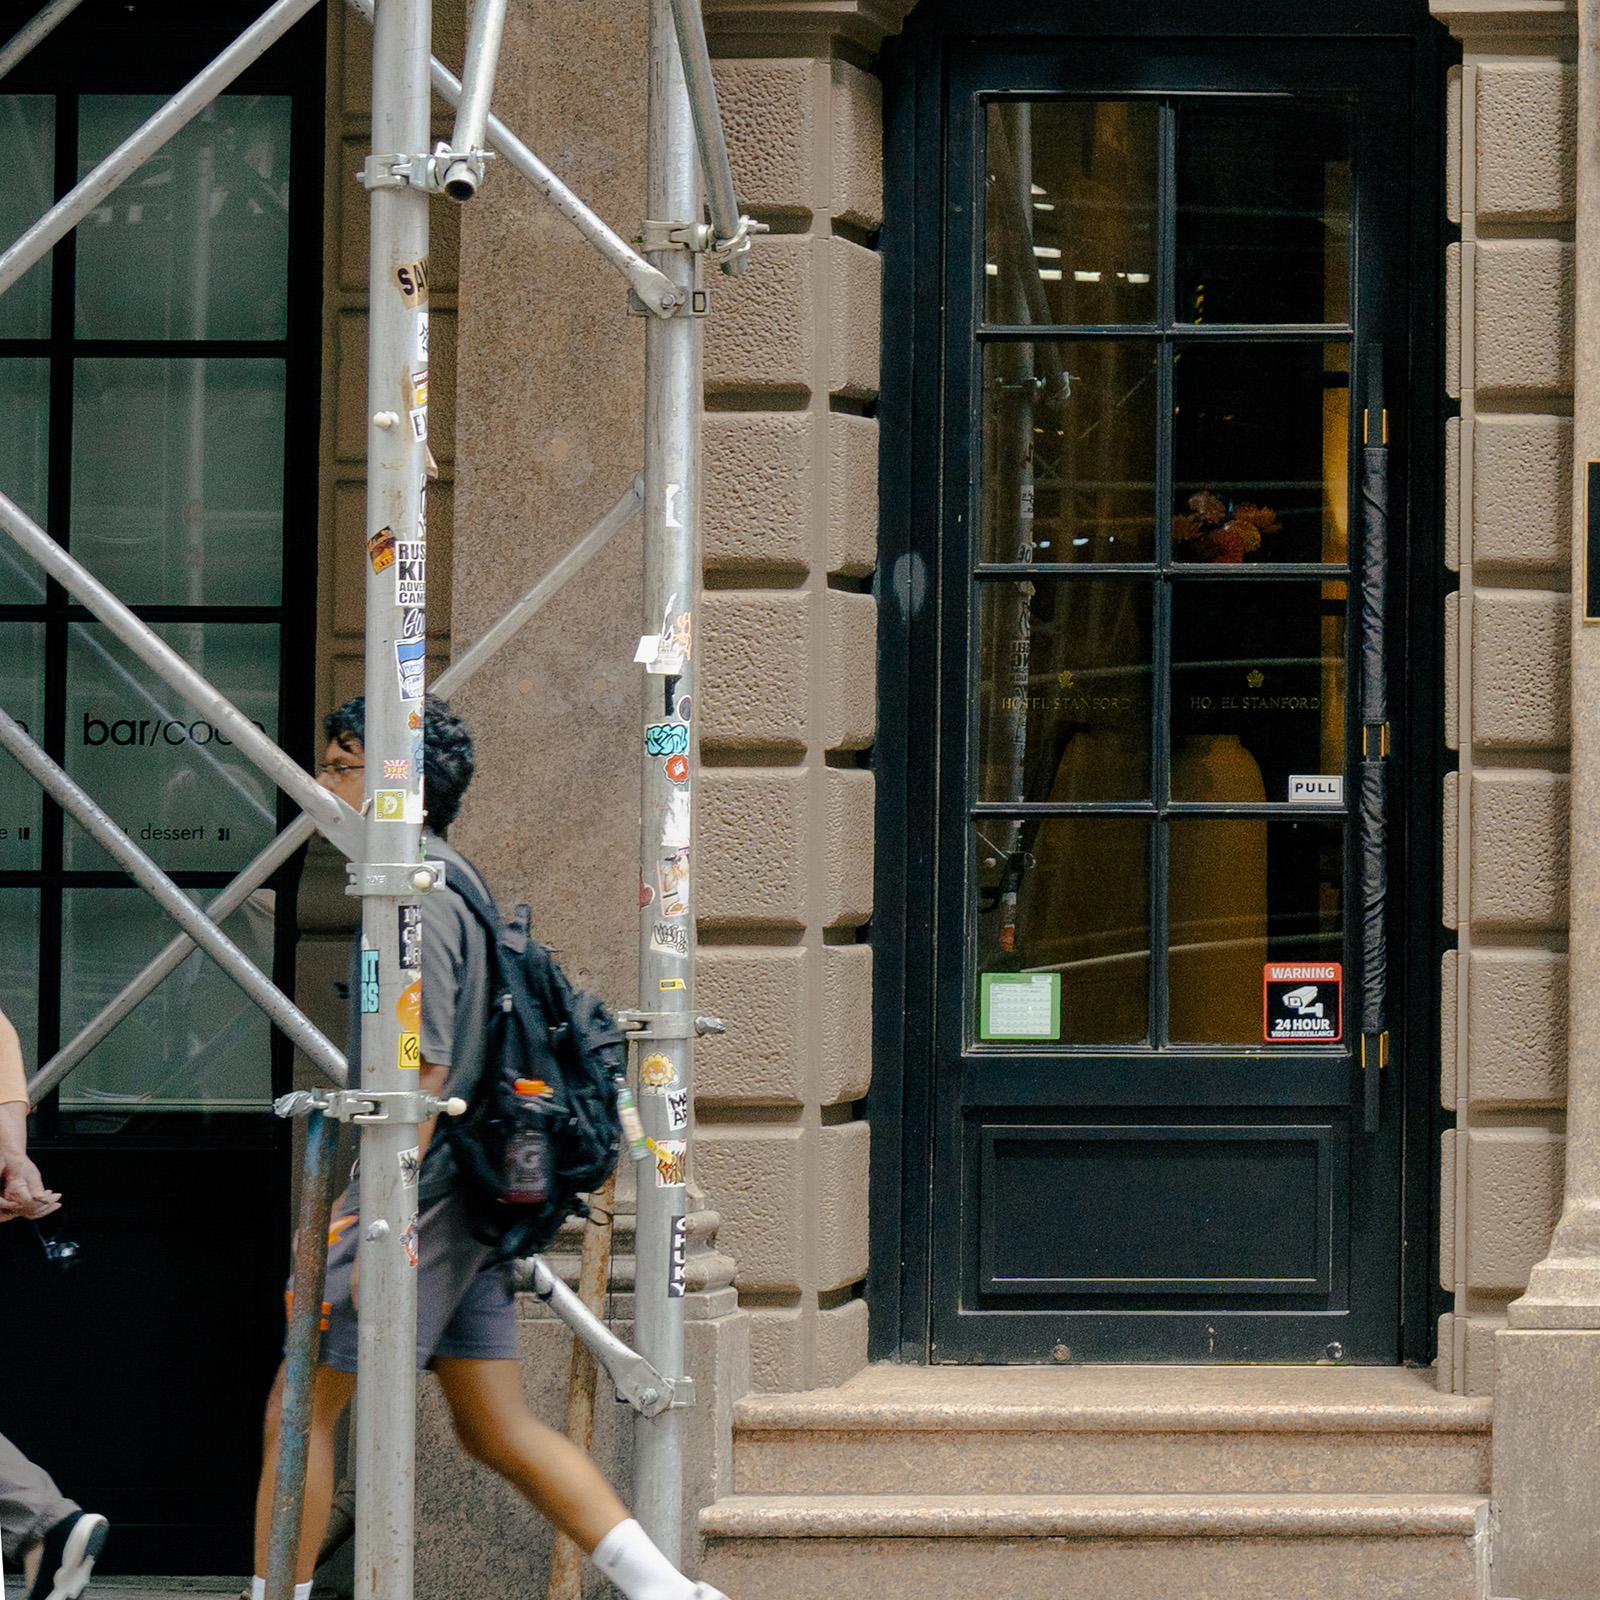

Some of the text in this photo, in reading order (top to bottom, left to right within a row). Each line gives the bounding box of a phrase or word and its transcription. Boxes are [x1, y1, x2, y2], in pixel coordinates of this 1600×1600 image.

[1190, 696, 1321, 710] HOEL STANFORD
[1295, 782, 1336, 793] PULL
[140, 823, 205, 840] dessert
[1271, 967, 1335, 979] WARNING
[1275, 1018, 1330, 1030] 24 HOUR
[1271, 1030, 1335, 1038] VIDEO SURVEILLANCE
